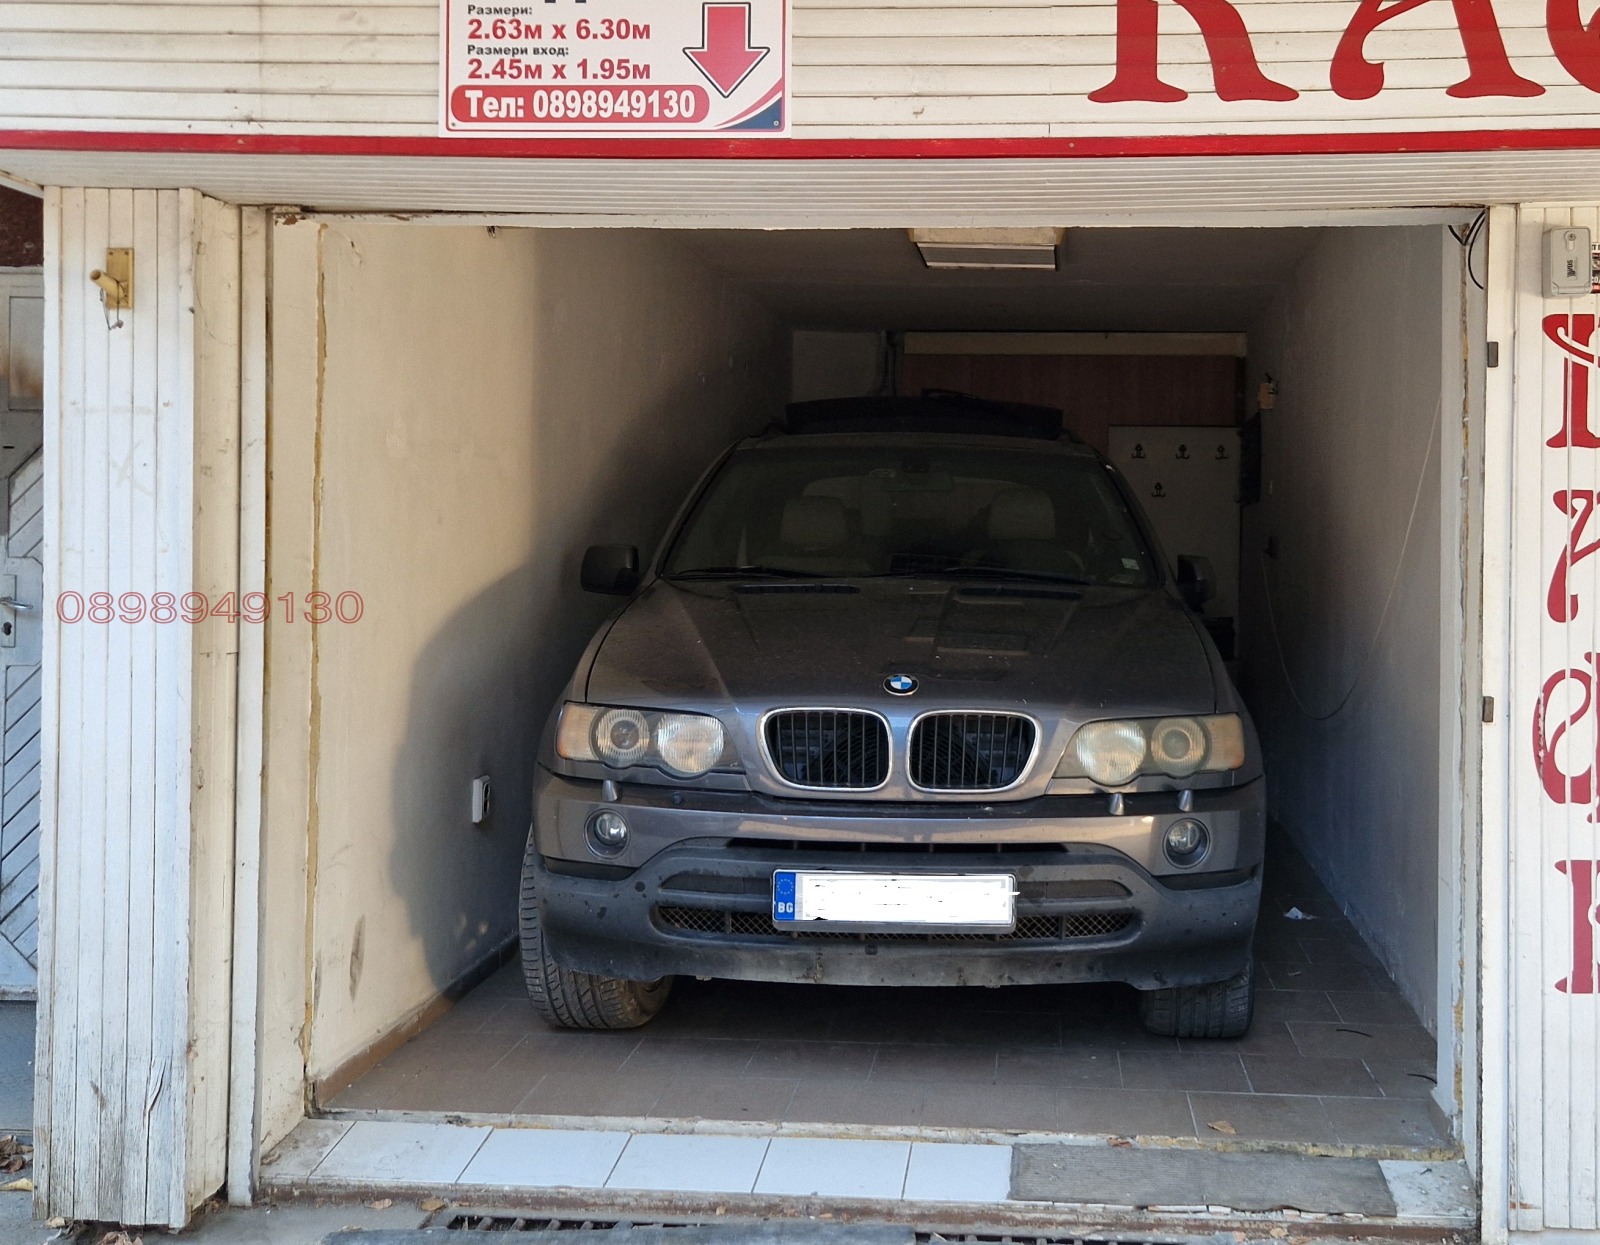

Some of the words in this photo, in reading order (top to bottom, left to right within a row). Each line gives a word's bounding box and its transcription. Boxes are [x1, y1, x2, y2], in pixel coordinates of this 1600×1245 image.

[467, 4, 533, 17] Размери:
[467, 18, 543, 40] 2.63м
[576, 18, 651, 40] 6.30м
[467, 44, 528, 57] Размери
[533, 46, 569, 57] вход:
[467, 58, 543, 80] 2.45м
[576, 58, 651, 80] 1.95м
[464, 89, 524, 118] Тел:
[532, 89, 696, 119] 0898949130
[777, 901, 794, 914] BG
